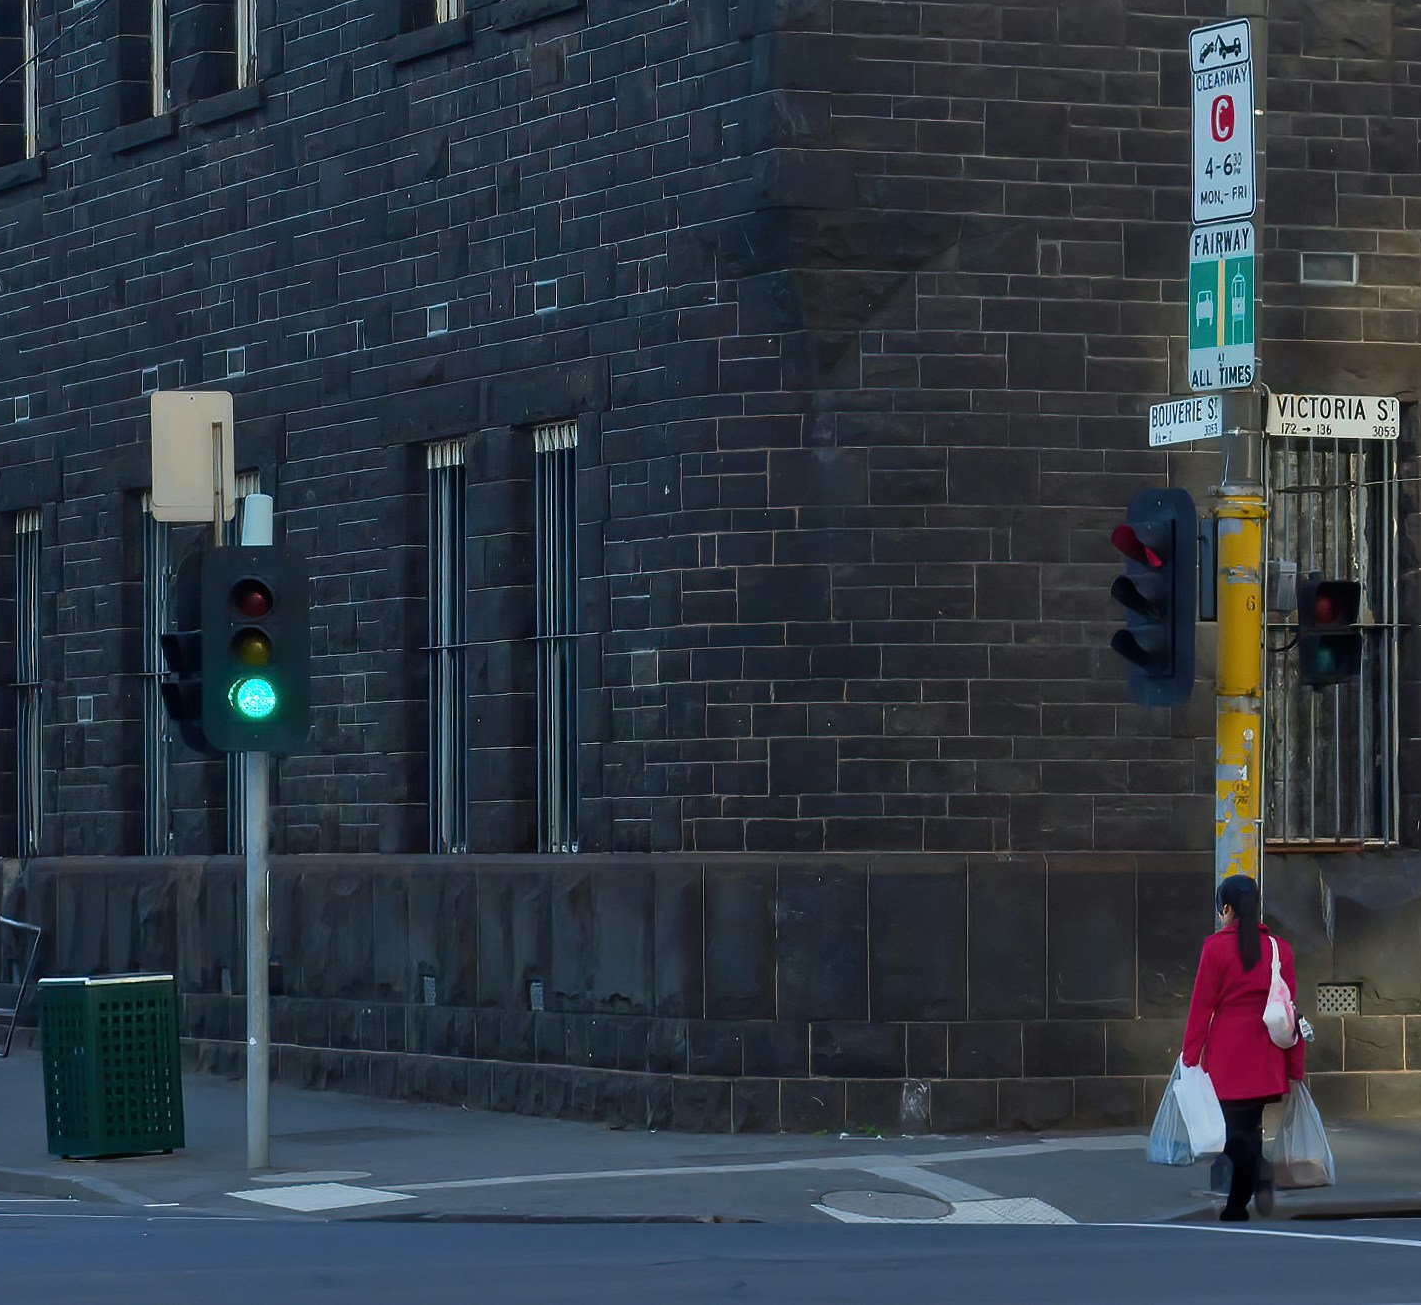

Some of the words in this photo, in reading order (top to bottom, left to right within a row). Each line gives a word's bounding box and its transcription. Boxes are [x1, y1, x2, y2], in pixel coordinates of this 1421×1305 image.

[1196, 64, 1248, 92] CLEARWAY
[1194, 227, 1250, 256] FAIRWAY
[1191, 368, 1213, 387] ALL
[1219, 364, 1252, 385] TIMES
[1151, 399, 1203, 428] BOUVERIE
[1276, 395, 1367, 421] VICTORIA
[1371, 425, 1397, 437] 3053
